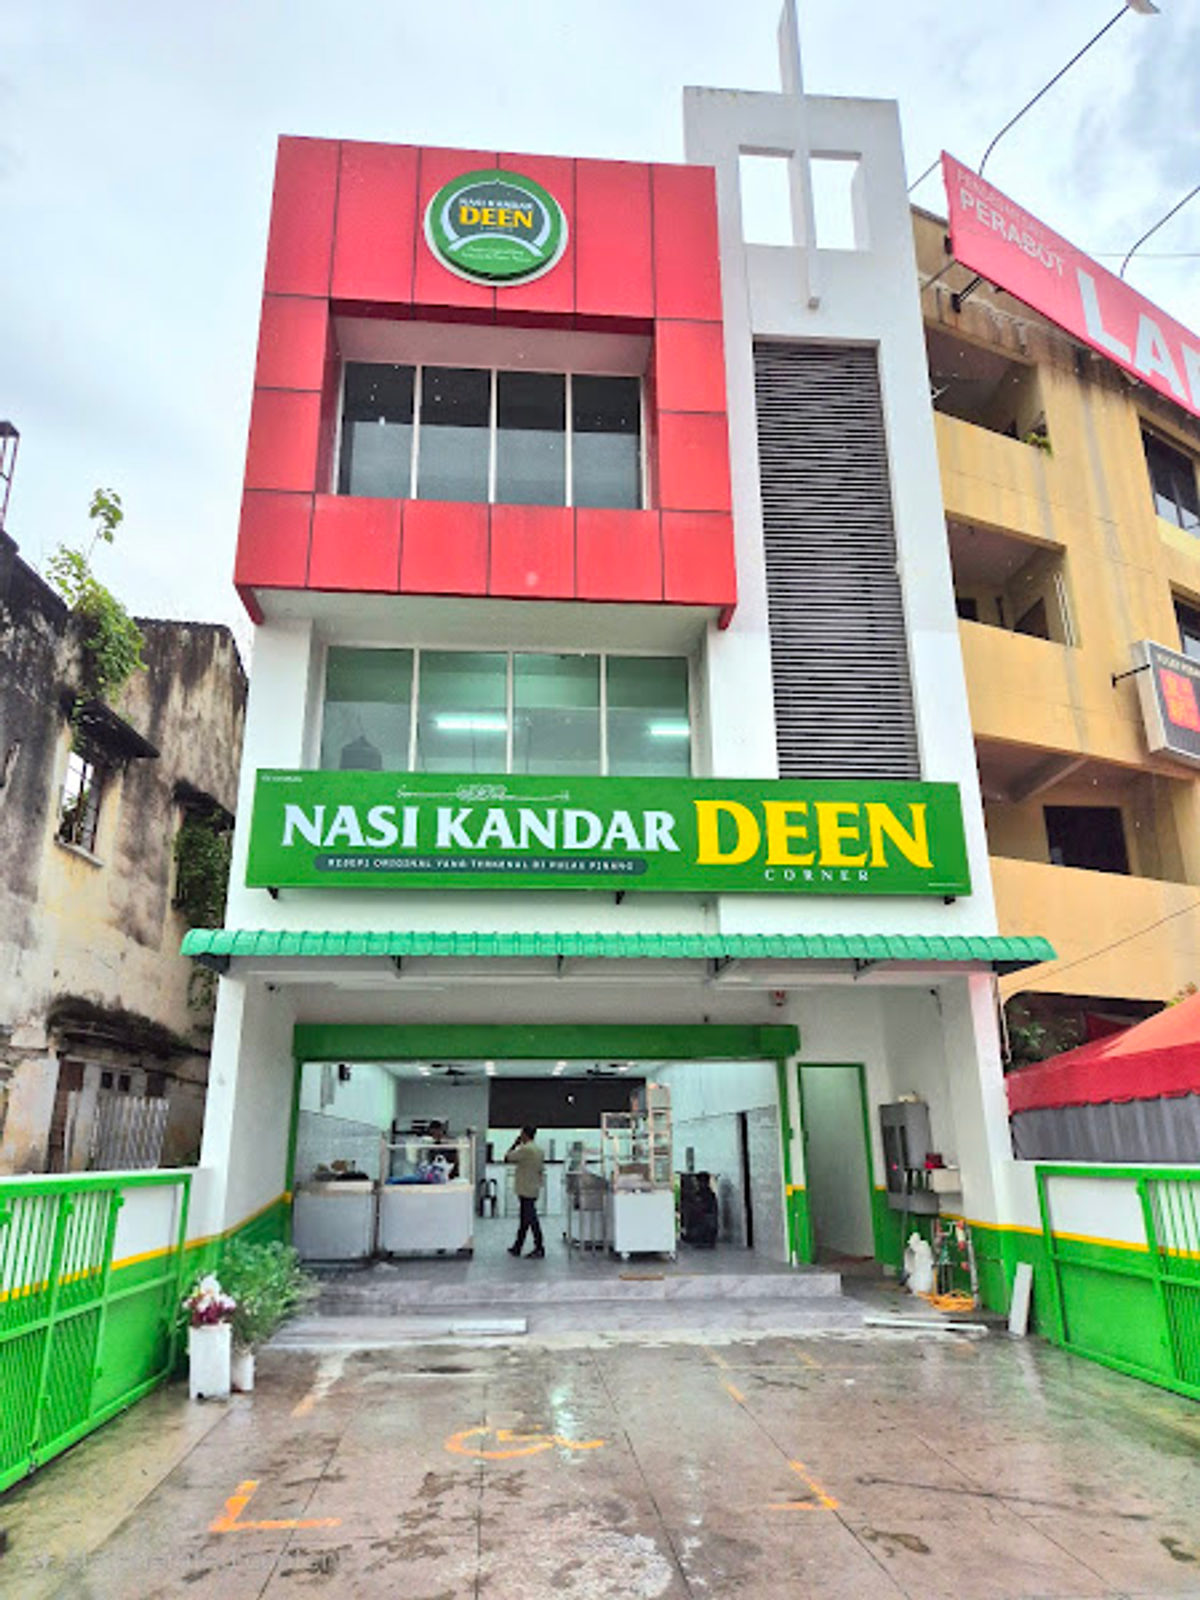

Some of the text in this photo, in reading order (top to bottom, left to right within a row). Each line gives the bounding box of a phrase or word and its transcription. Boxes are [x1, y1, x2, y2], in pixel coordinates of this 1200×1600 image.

[459, 206, 533, 229] DEEN
[960, 187, 1063, 277] PERABOT
[281, 800, 934, 868] NASI KANDAR DEEN
[764, 868, 869, 881] CORNER
